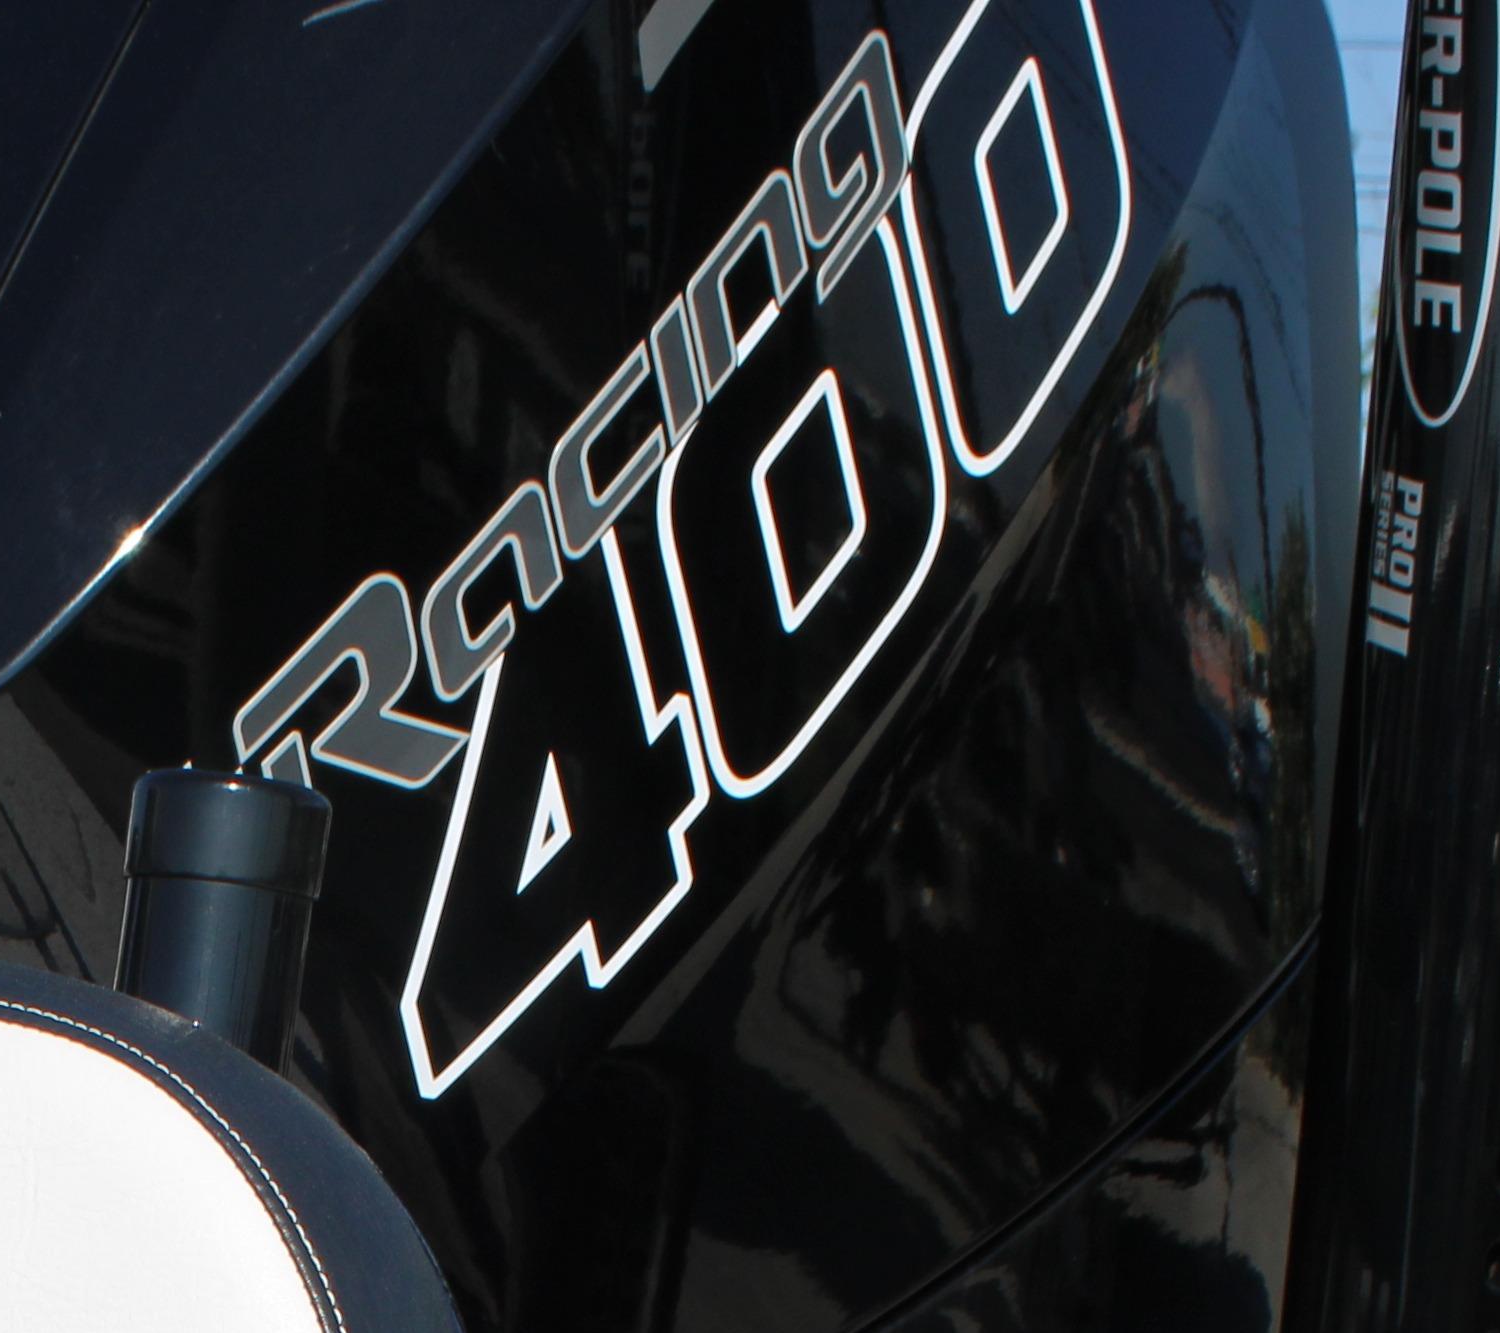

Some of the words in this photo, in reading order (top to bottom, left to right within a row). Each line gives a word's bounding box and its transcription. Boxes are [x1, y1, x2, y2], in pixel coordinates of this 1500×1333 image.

[1413, 0, 1463, 333] R-POLE
[233, 29, 910, 789] Racing
[401, 0, 1130, 1098] 400
[1373, 470, 1396, 578] SERIES
[1388, 474, 1424, 589] PRO
